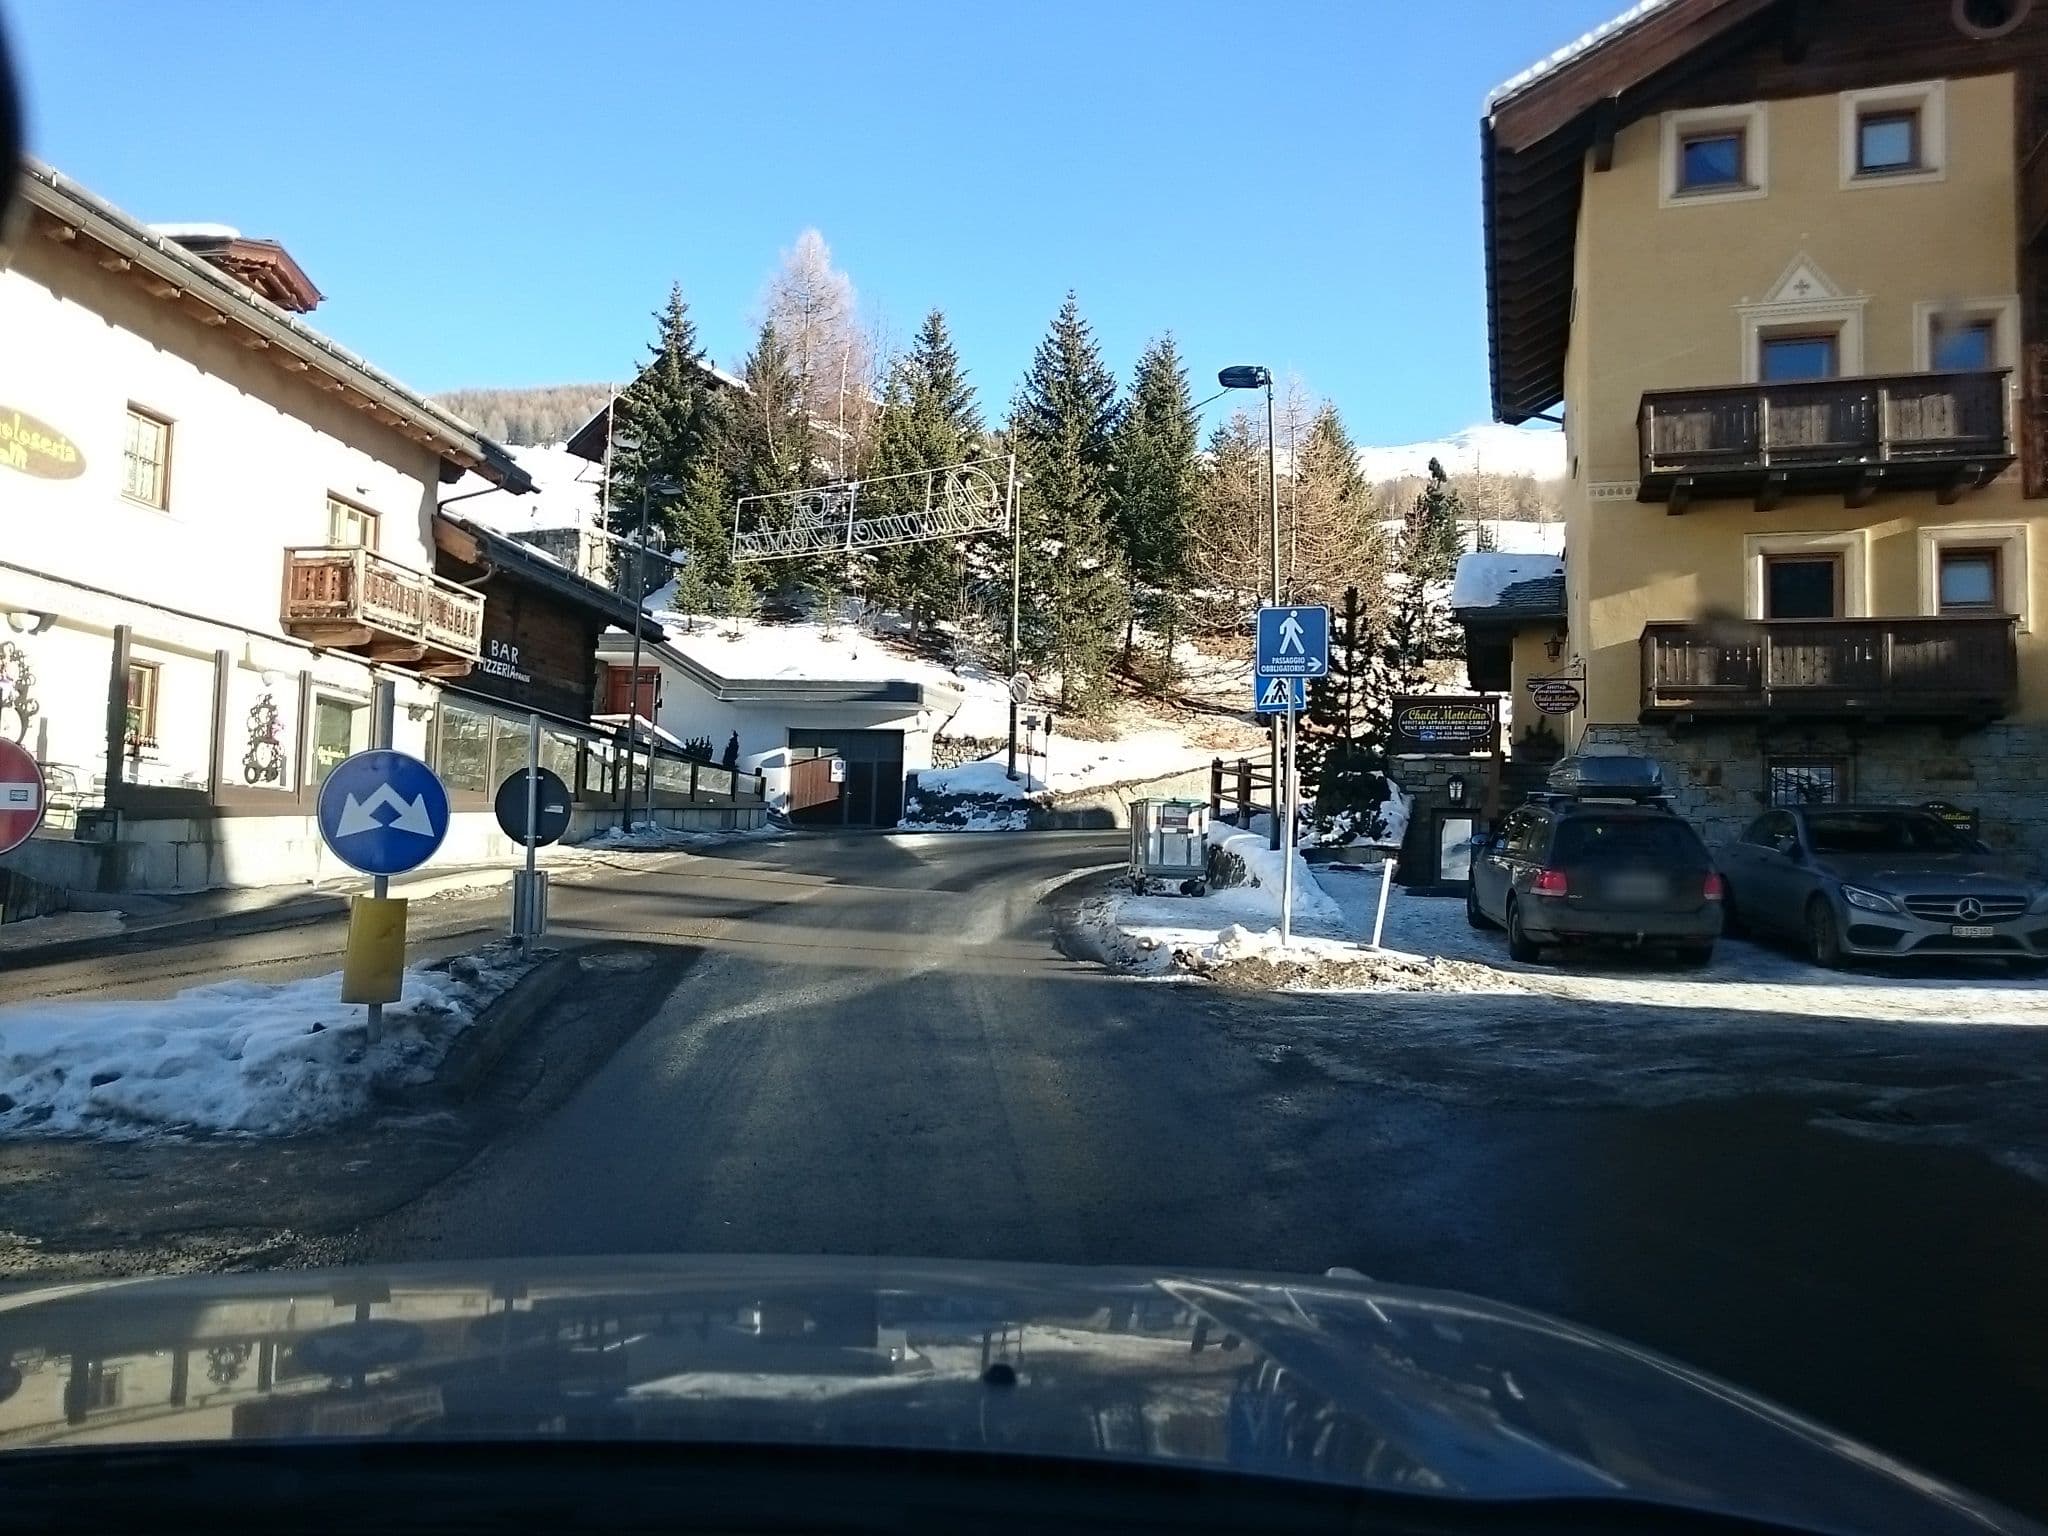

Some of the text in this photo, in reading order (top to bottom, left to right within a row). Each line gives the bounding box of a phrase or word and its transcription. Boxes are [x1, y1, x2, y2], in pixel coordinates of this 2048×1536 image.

[0, 413, 76, 463] oloseria
[492, 640, 518, 664] BAR
[1408, 709, 1486, 720] Chalet Mottolino
